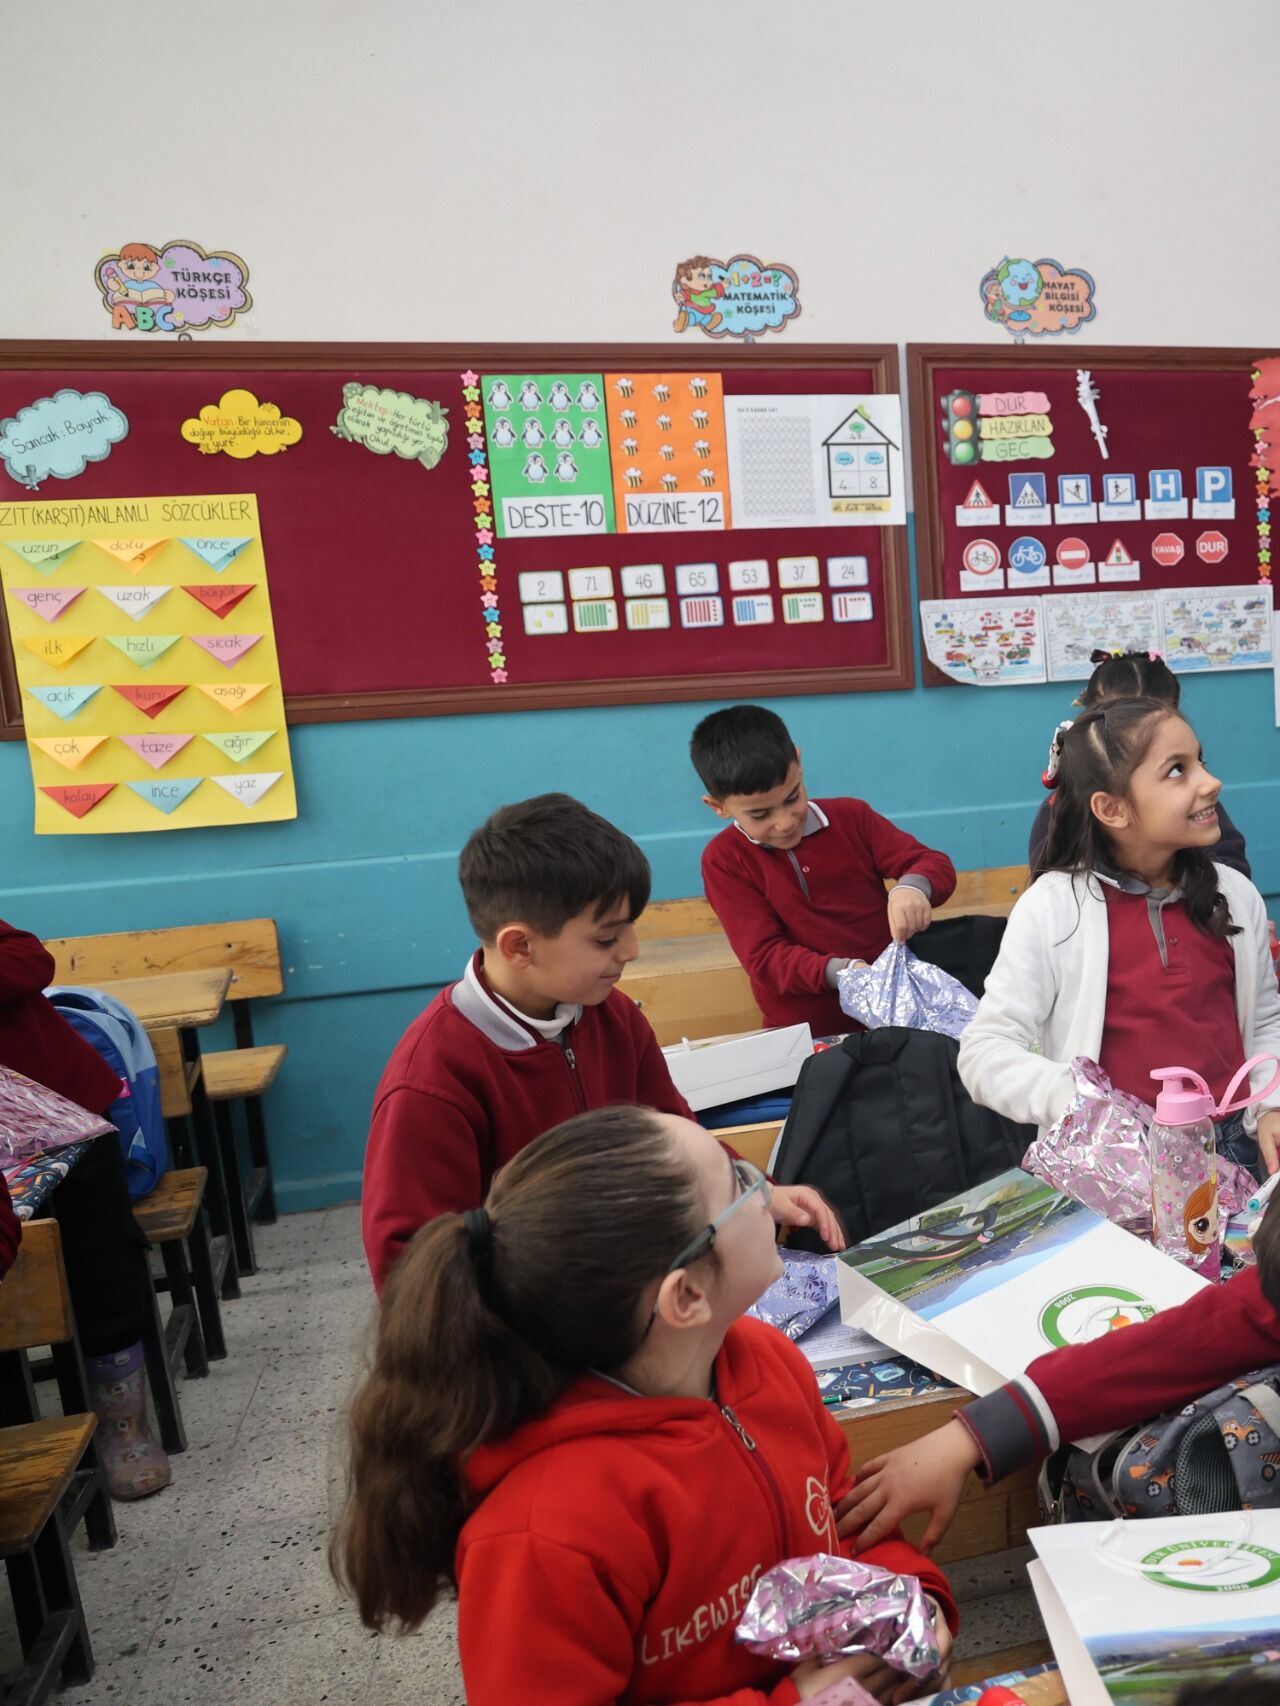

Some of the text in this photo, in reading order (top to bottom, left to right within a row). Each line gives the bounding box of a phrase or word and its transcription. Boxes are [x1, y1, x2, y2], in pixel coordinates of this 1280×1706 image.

[171, 268, 232, 284] TÜRKÇE
[176, 285, 230, 301] KÖŞESİ
[1044, 282, 1075, 290] HAYAT
[724, 290, 788, 300] MATEMATİK
[1044, 291, 1080, 301] BİLGİSİ
[736, 303, 776, 316] KÖŞESİ
[1049, 302, 1084, 314] KÖŞESİ
[112, 305, 176, 331] ABC
[995, 396, 1026, 412] DUR
[989, 419, 1045, 435] HAZIRLAN
[870, 476, 878, 489] 8
[1156, 474, 1176, 499] H
[1204, 471, 1226, 502] P
[88, 504, 149, 524] ANLAMLI
[162, 500, 252, 520] SÖZCÜKLER
[508, 500, 604, 529] DESTE-10
[627, 498, 722, 527] DÜZİNE-12
[22, 538, 230, 554] uzun dolu önce
[1153, 545, 1182, 554] YAVAŞ
[1200, 540, 1224, 553] DUR
[537, 563, 856, 597] 2 71 46 65 53 37 24
[27, 590, 62, 608] genç
[116, 588, 151, 601] uzak
[44, 636, 242, 654] ilk hızlı sıcak
[46, 688, 74, 704] açık
[54, 736, 253, 755] çok taze ağır
[64, 777, 257, 805] kolay ince yaz
[1216, 1584, 1250, 1592] 2008
